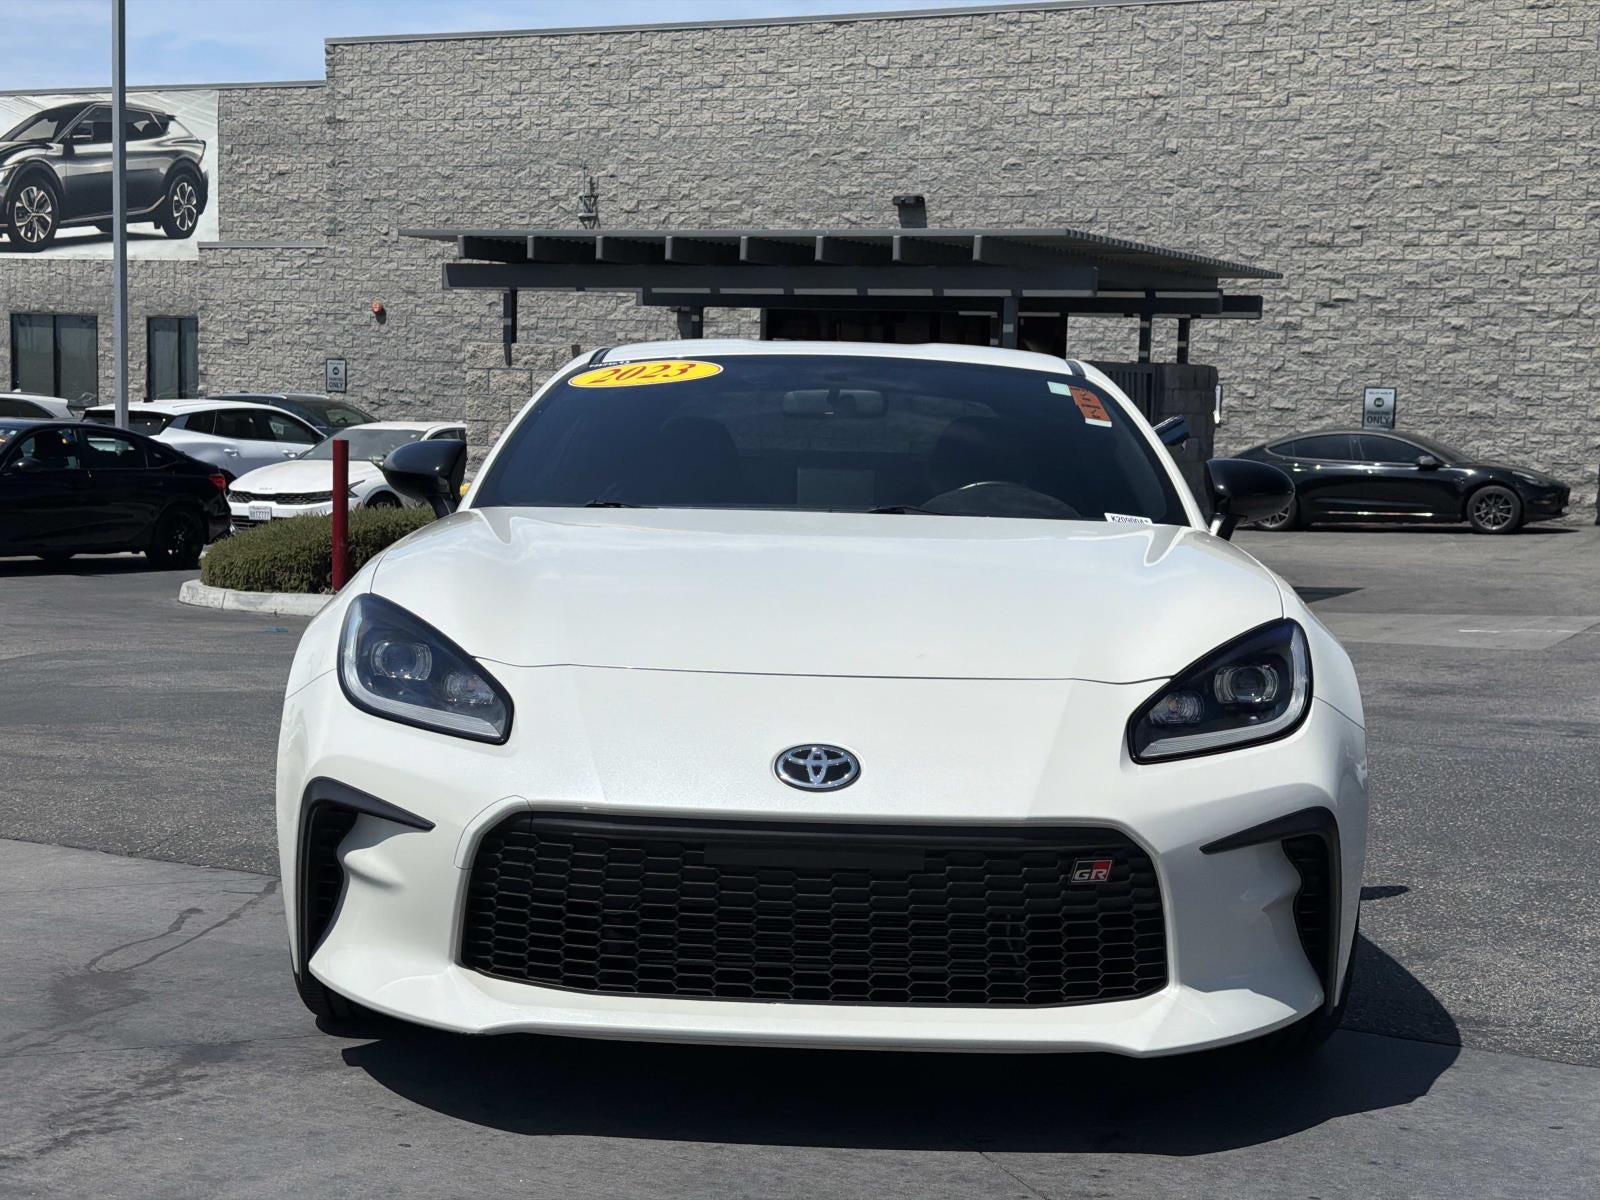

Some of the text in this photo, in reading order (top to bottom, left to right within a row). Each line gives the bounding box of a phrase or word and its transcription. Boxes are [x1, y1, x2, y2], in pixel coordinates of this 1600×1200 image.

[588, 363, 697, 385] 2023
[1366, 415, 1392, 424] ONLY
[1075, 869, 1108, 880] GR
